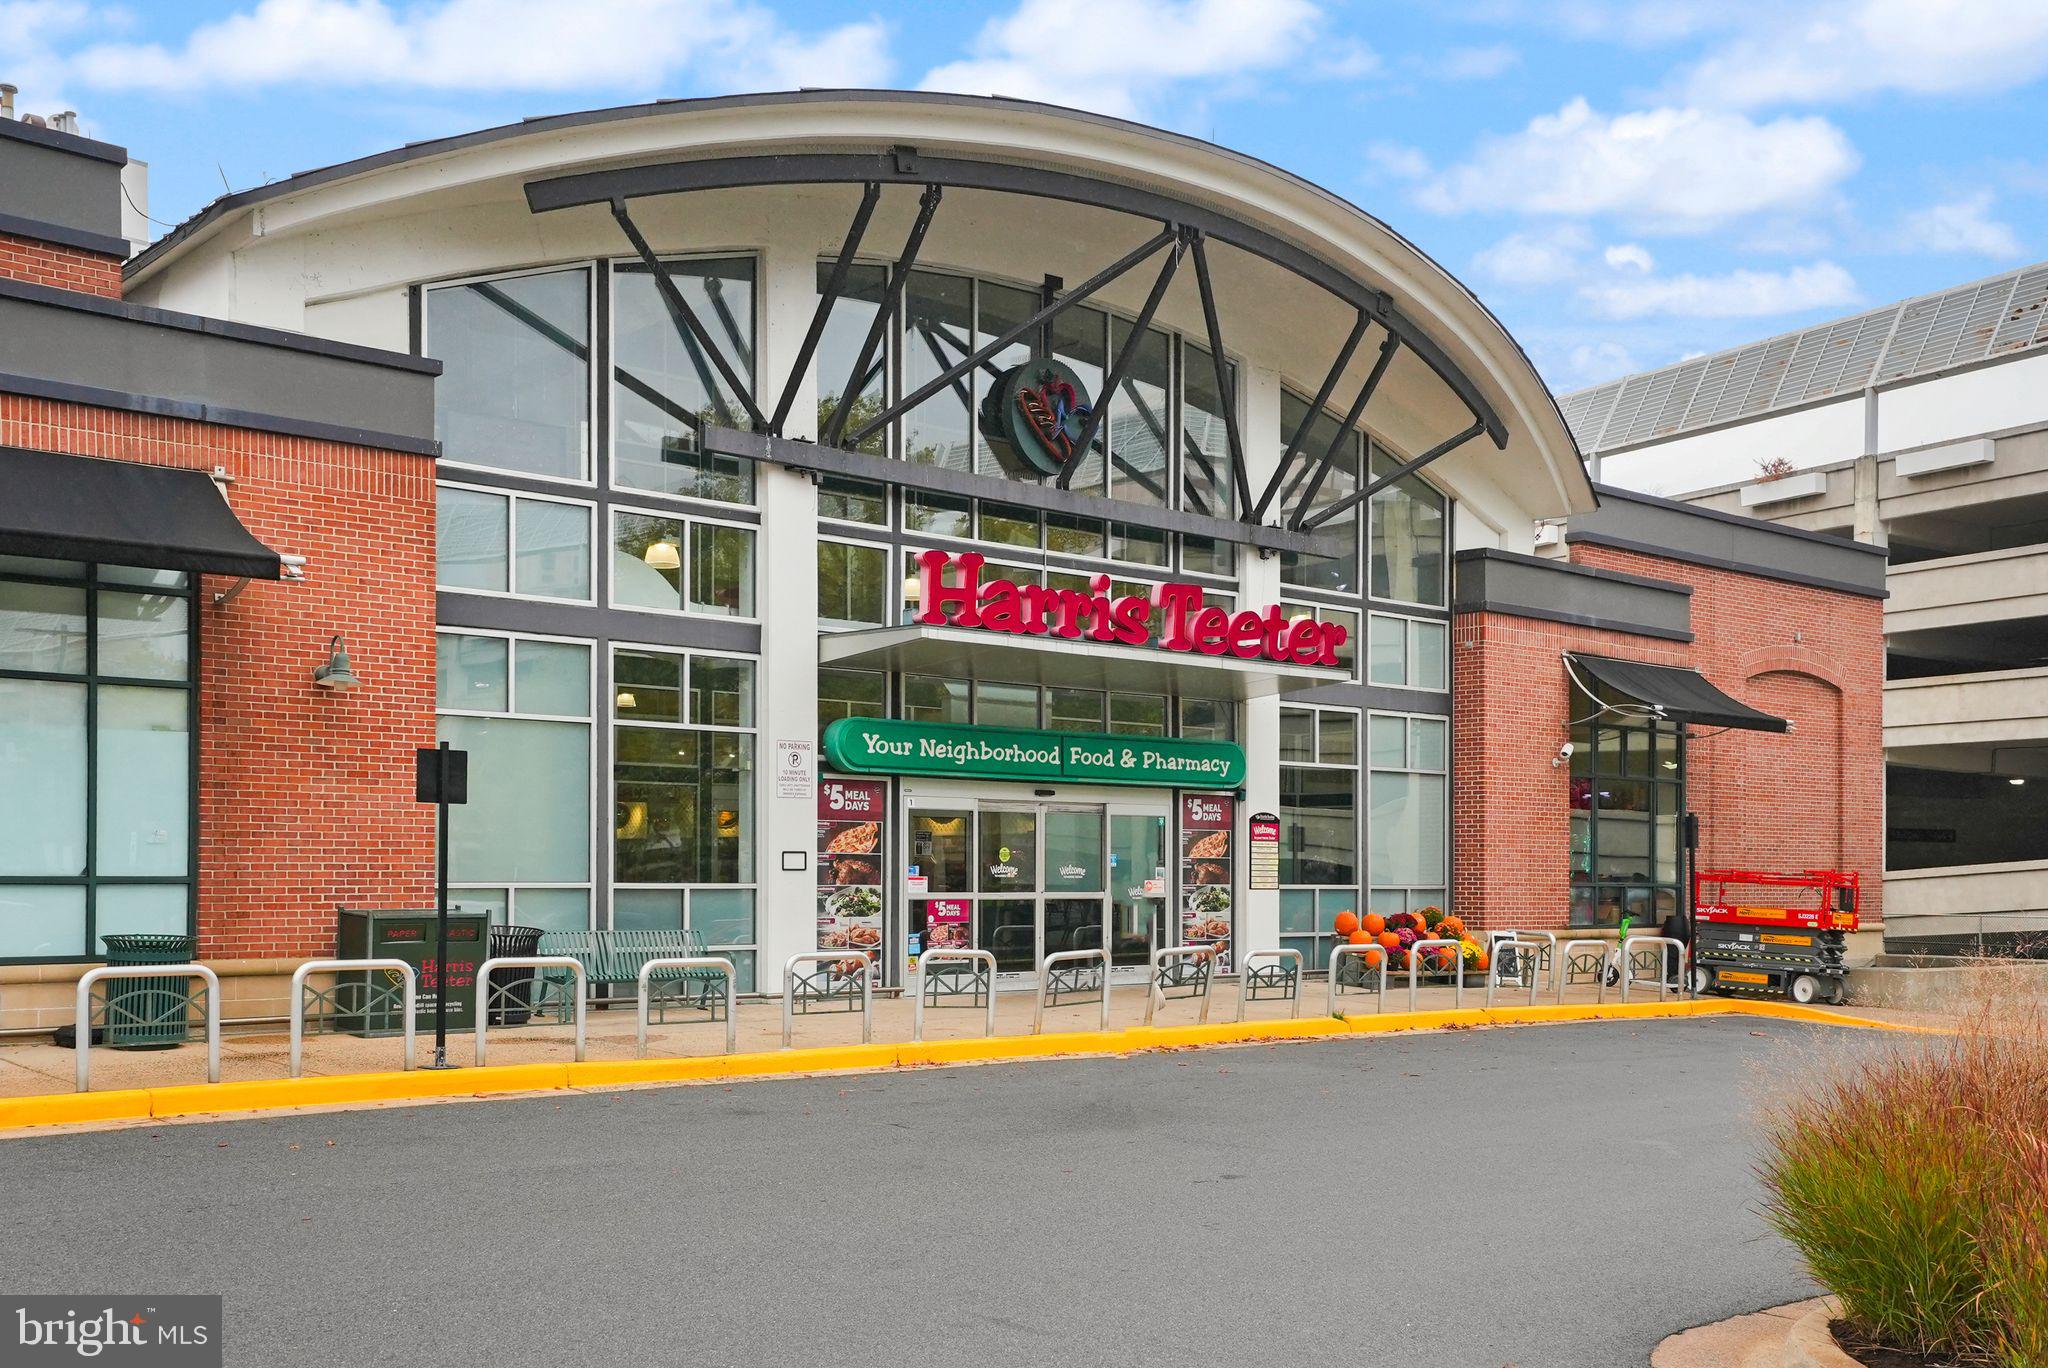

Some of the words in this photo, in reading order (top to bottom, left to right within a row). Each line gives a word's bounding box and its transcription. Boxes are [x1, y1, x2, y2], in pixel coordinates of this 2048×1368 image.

[913, 550, 1150, 645] Harris
[1151, 582, 1348, 666] Teeter
[788, 743, 811, 751] PARKING
[862, 732, 913, 756] Your
[919, 738, 1061, 765] Neighborhood
[1070, 747, 1115, 768] Food
[1120, 748, 1137, 768] &
[1142, 751, 1231, 778] Pharmacy
[823, 784, 845, 810] $5
[845, 790, 871, 801] MEAL
[845, 801, 870, 811] DAYS
[1187, 798, 1203, 821] $5
[1202, 803, 1222, 813] MEAL
[1202, 813, 1222, 821] DAYS
[1253, 824, 1277, 836] Welcome
[990, 862, 1019, 875] Welcome
[1059, 864, 1086, 876] Welcome
[1696, 906, 1728, 914] SKYJACK
[388, 928, 417, 937] PAPER
[447, 928, 475, 937] ASTIC
[1718, 942, 1751, 950] SKYJACK
[421, 959, 474, 973] Hrris
[421, 974, 473, 988] Teter
